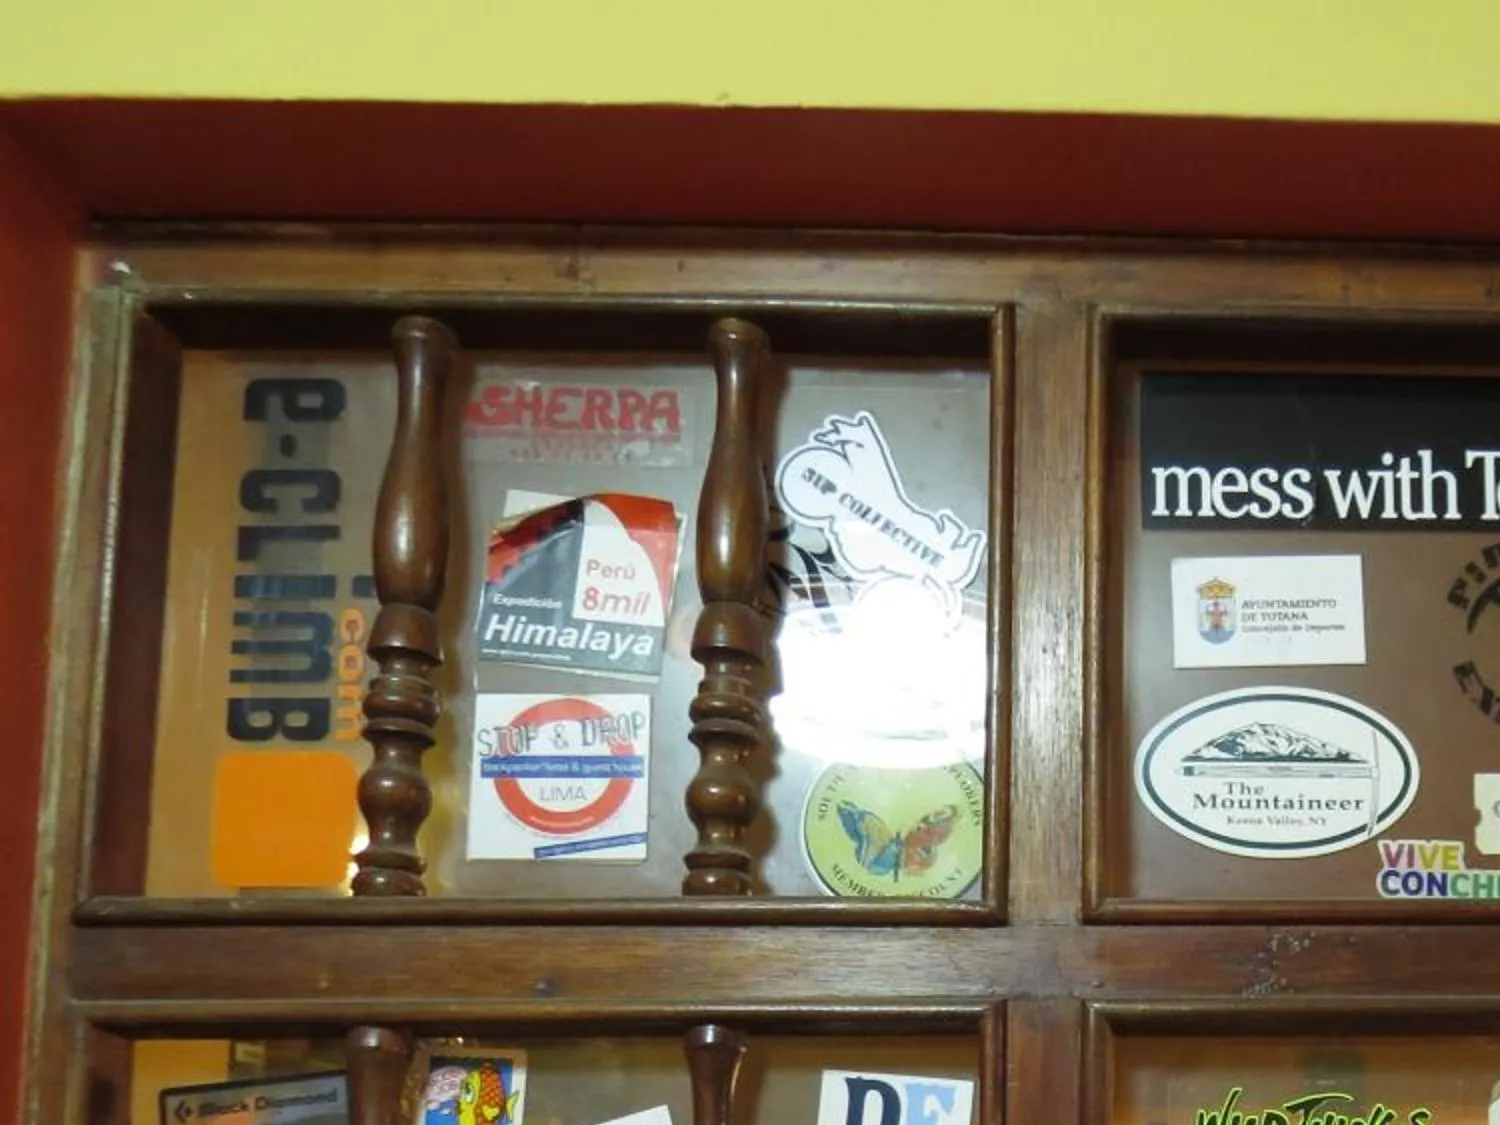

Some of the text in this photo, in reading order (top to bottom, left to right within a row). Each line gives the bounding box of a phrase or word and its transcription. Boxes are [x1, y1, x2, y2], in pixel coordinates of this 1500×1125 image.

[463, 386, 681, 434] SHERPA
[1152, 464, 1314, 519] mess
[1324, 450, 1461, 521] with
[838, 491, 945, 569] COLLECTIVE
[1241, 598, 1338, 610] AYUNTAMIENTO
[1241, 611, 1257, 622] DE
[484, 614, 655, 660] Himalaya
[540, 785, 588, 803] LIMA
[1227, 782, 1265, 796] The
[1192, 791, 1366, 812] Mountaineer
[1383, 844, 1463, 870] VIVE
